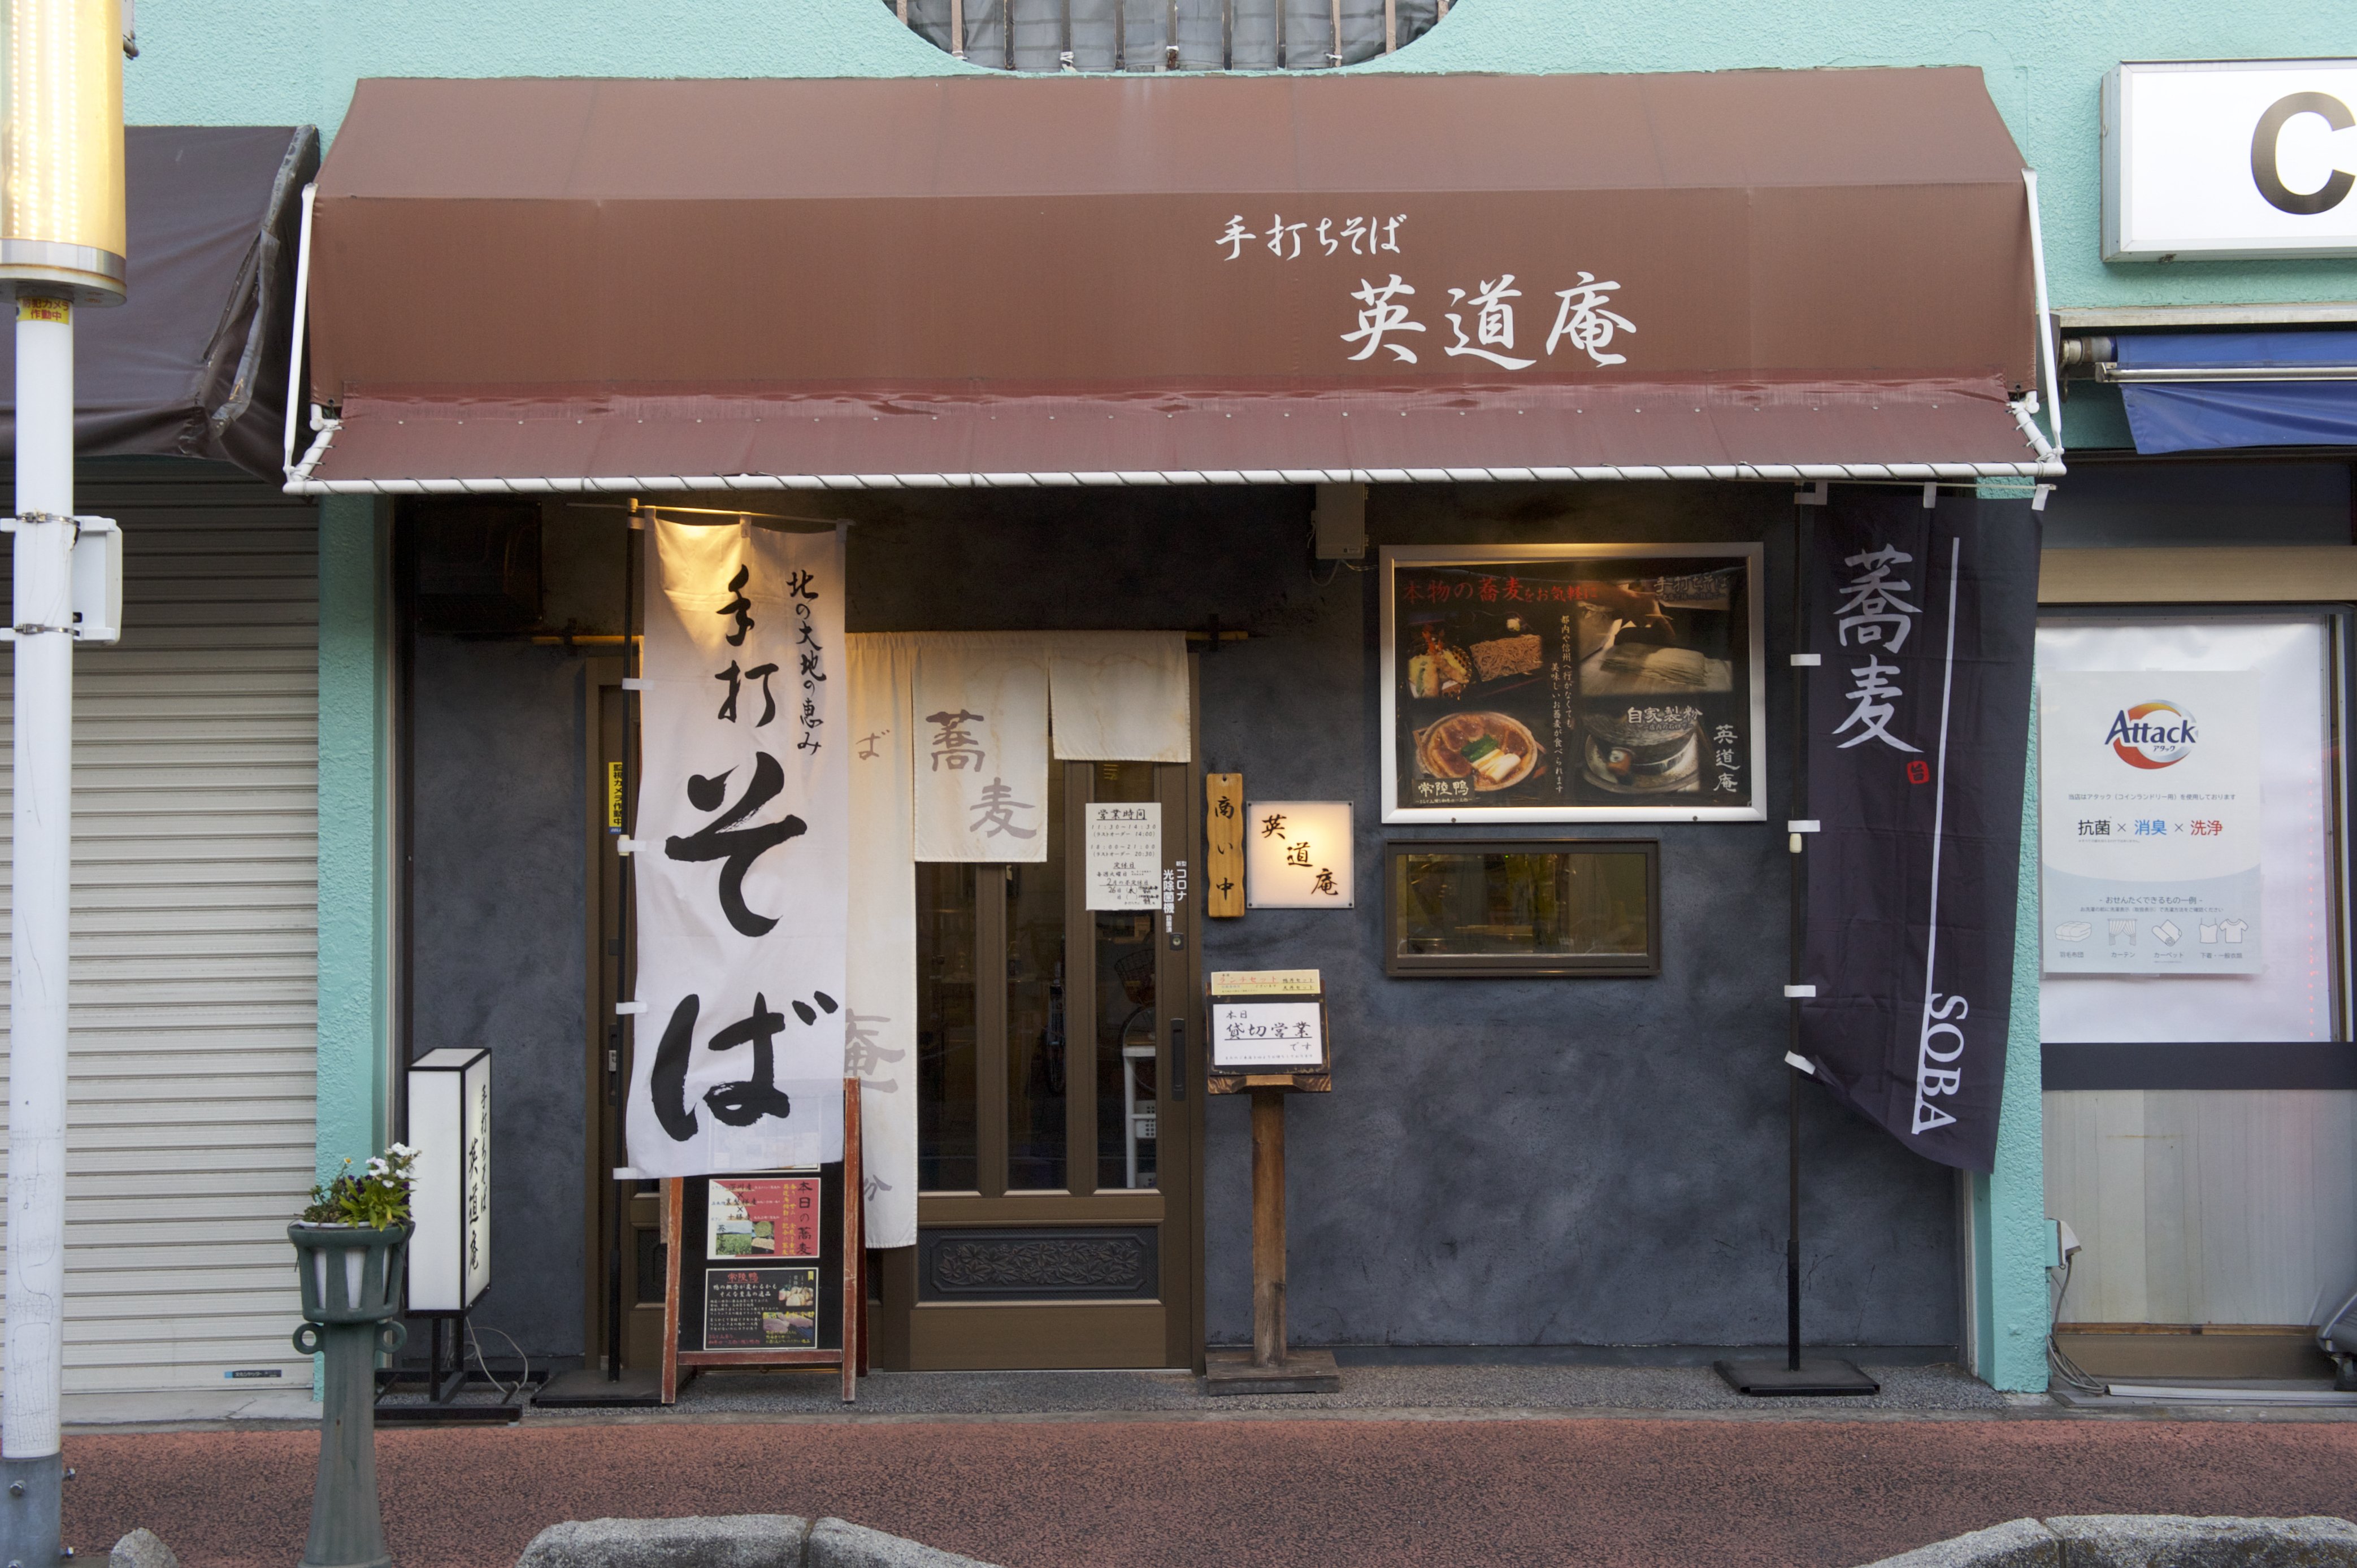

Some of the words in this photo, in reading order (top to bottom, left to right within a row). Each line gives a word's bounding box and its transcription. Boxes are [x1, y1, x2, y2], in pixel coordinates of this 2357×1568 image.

[2251, 92, 2356, 215] C
[1215, 213, 1408, 261] 手打ちそば
[31, 309, 62, 320] 作動中
[1340, 271, 1637, 370] 英道庵
[786, 569, 827, 755] 北の大地の恵み
[1831, 542, 1924, 753] 蕎麦
[1627, 705, 1703, 723] 自家製粉
[2104, 710, 2197, 745] Attack
[925, 709, 1038, 840] 蕎麦
[1418, 780, 1469, 797] 常陸鴨
[1713, 724, 1741, 792] 英道庵
[1098, 809, 1146, 820] 営業時間
[1214, 796, 1235, 900] 商い中
[2078, 819, 2111, 836] 抗菌
[2134, 819, 2167, 836] 消臭
[2190, 820, 2223, 836] 洗浄
[1261, 814, 1338, 897] 英道庵
[1226, 1010, 1247, 1019] 本日
[1226, 1021, 1310, 1039] 貸切営業
[1290, 1042, 1312, 1051] です
[1912, 993, 1969, 1131] SOBA
[468, 1137, 479, 1276] 英道庵
[797, 1181, 813, 1255] 本日の蕎麦
